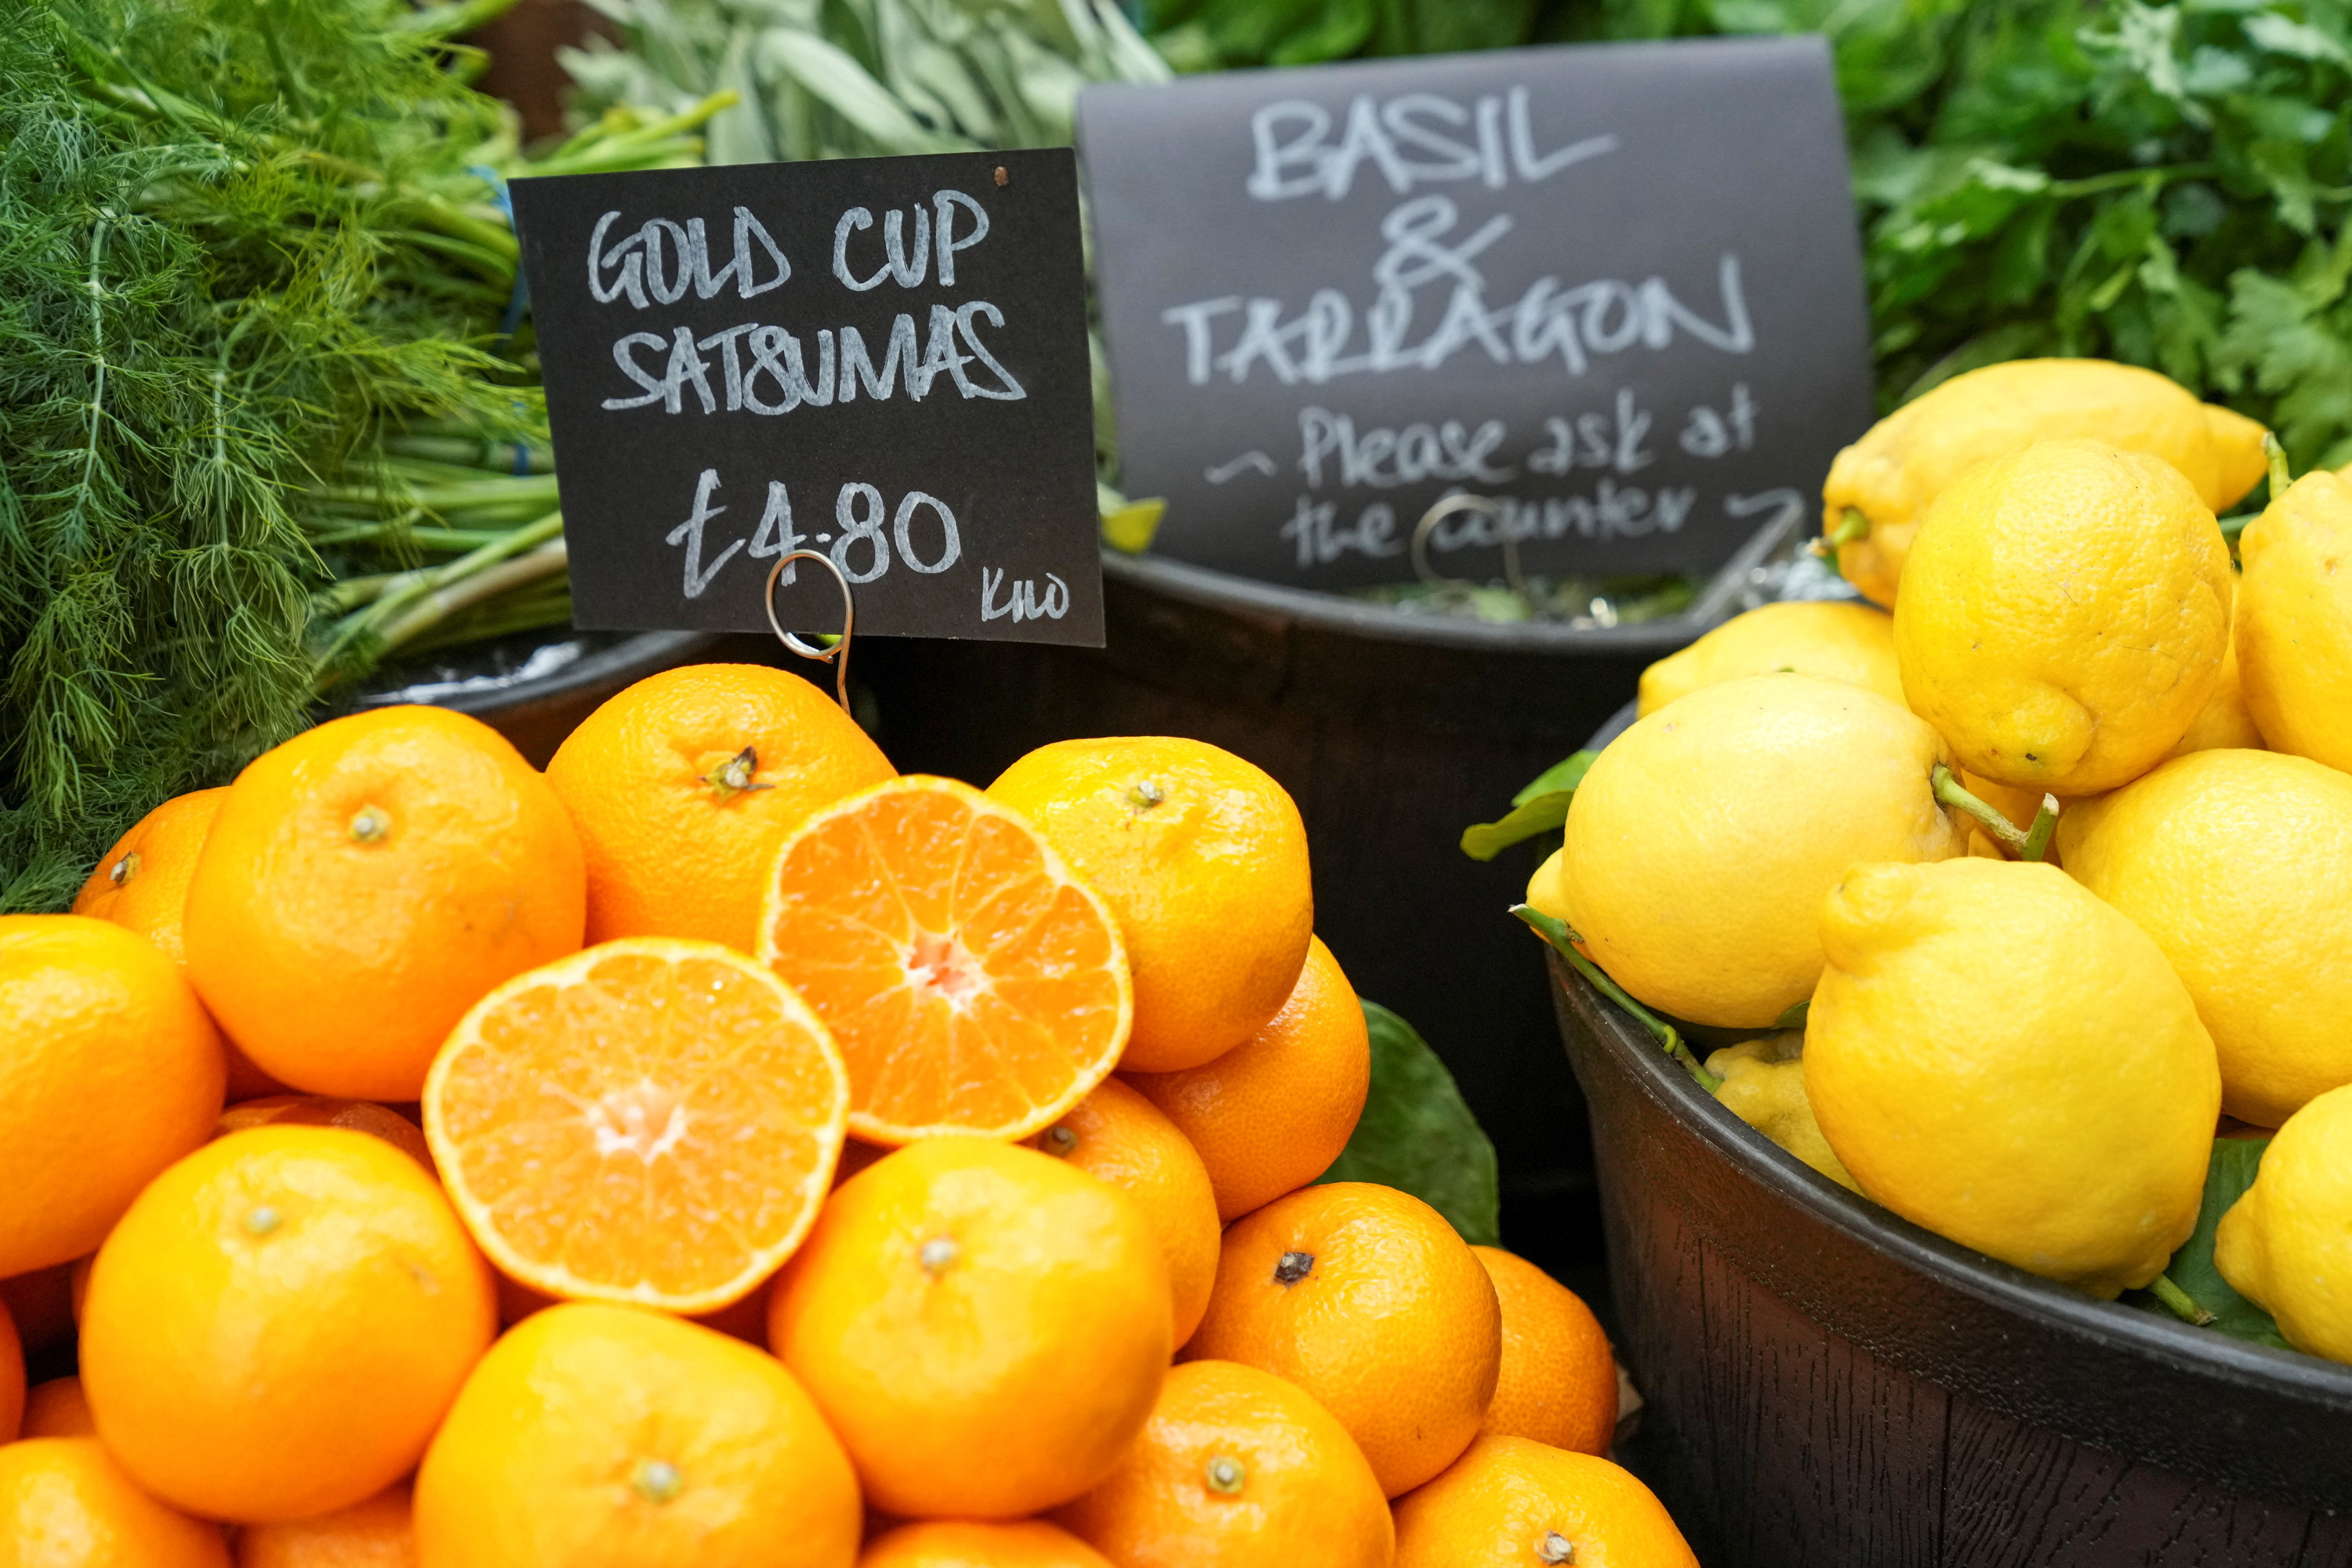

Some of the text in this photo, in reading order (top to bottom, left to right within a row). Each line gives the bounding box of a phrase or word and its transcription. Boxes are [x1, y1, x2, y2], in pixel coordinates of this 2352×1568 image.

[1248, 85, 1619, 201] BASIL
[587, 189, 989, 309] GOLD CUP
[1375, 194, 1515, 295] &
[601, 301, 1027, 416] SATSUMAS
[1162, 252, 1754, 384] TARRAGON
[1297, 383, 1759, 488] Please ask at
[666, 468, 961, 599] £4.80
[1281, 495, 1403, 568] the
